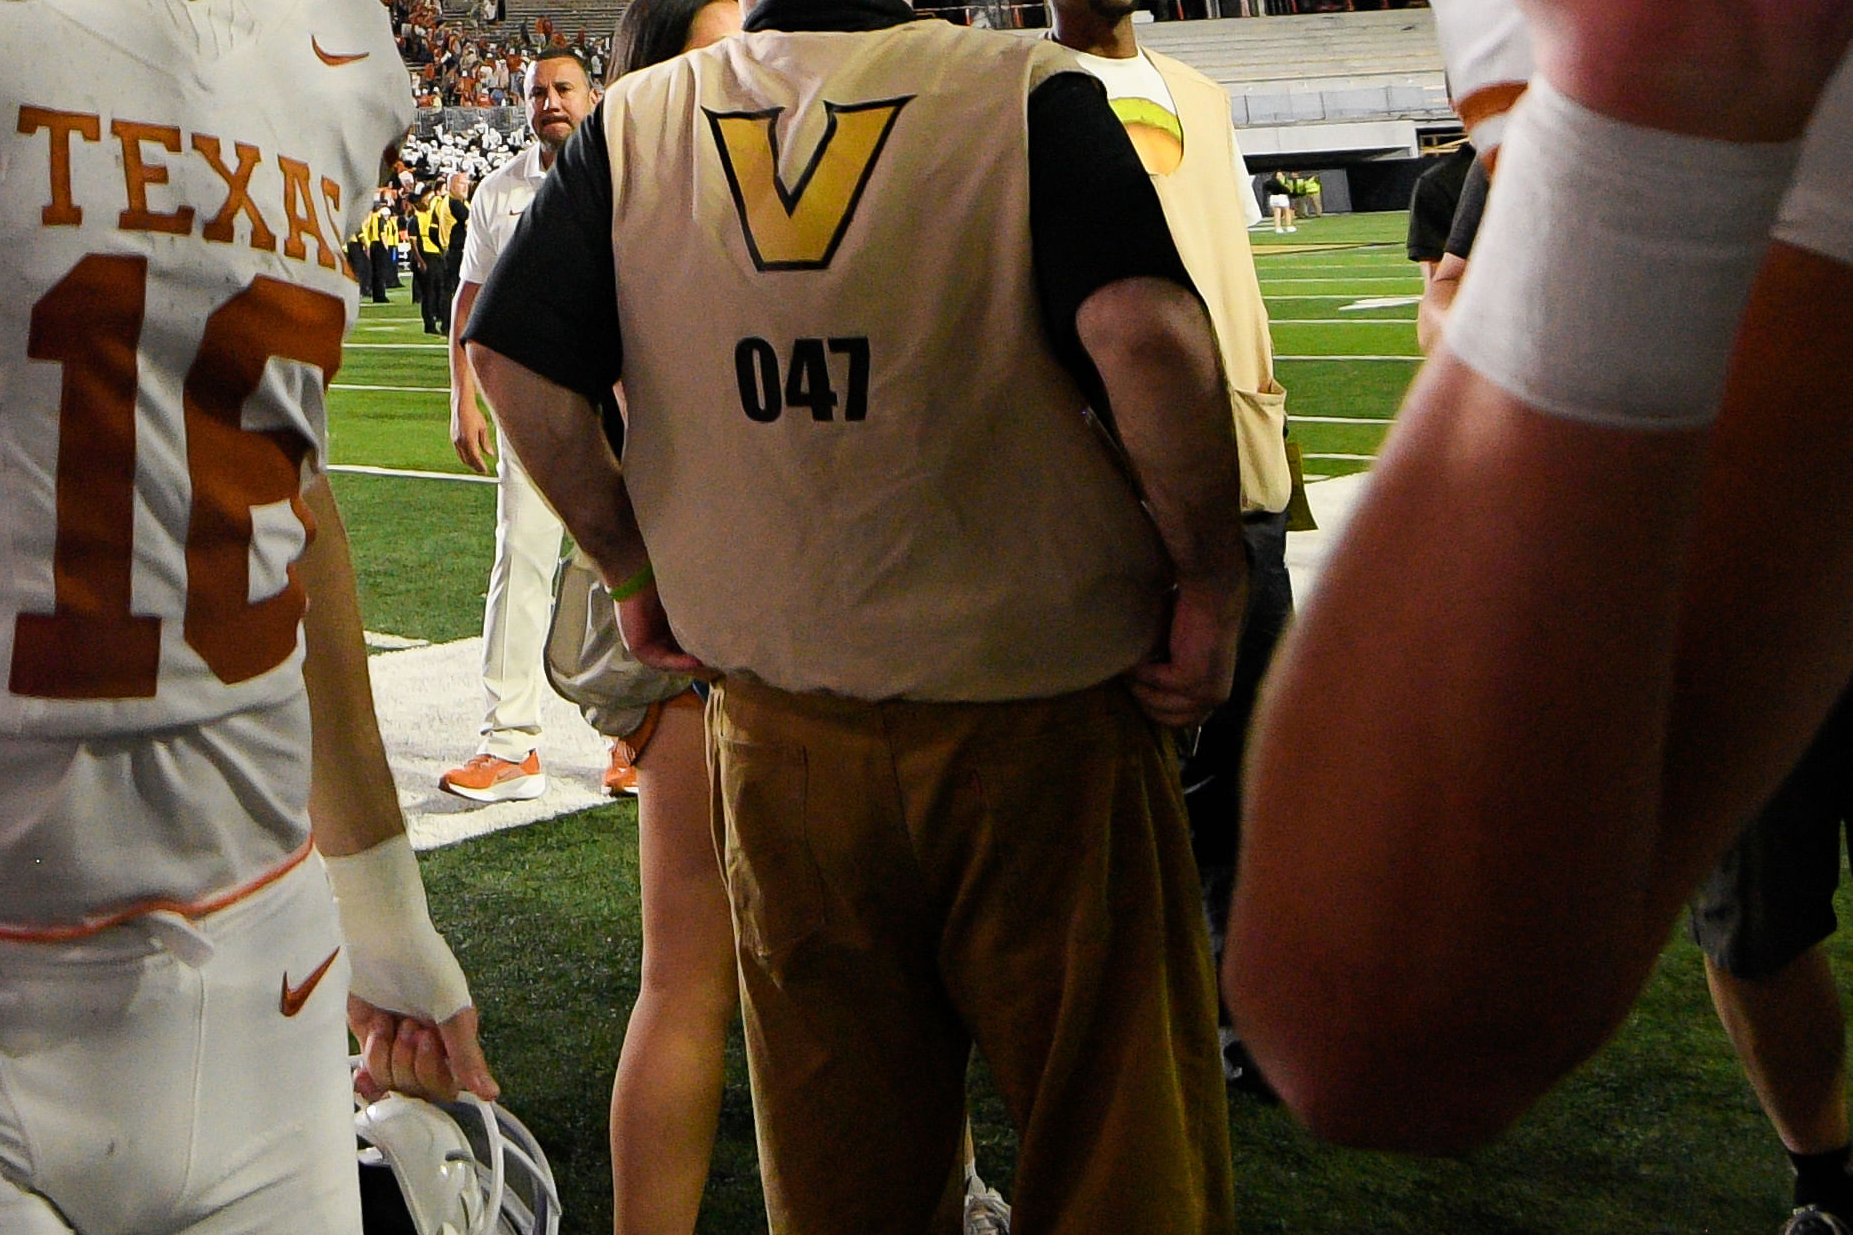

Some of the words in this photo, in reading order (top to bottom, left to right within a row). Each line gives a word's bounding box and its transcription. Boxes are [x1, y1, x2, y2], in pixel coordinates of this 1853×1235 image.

[700, 94, 918, 272] V
[734, 336, 871, 422] 047
[9, 253, 345, 698] 16
